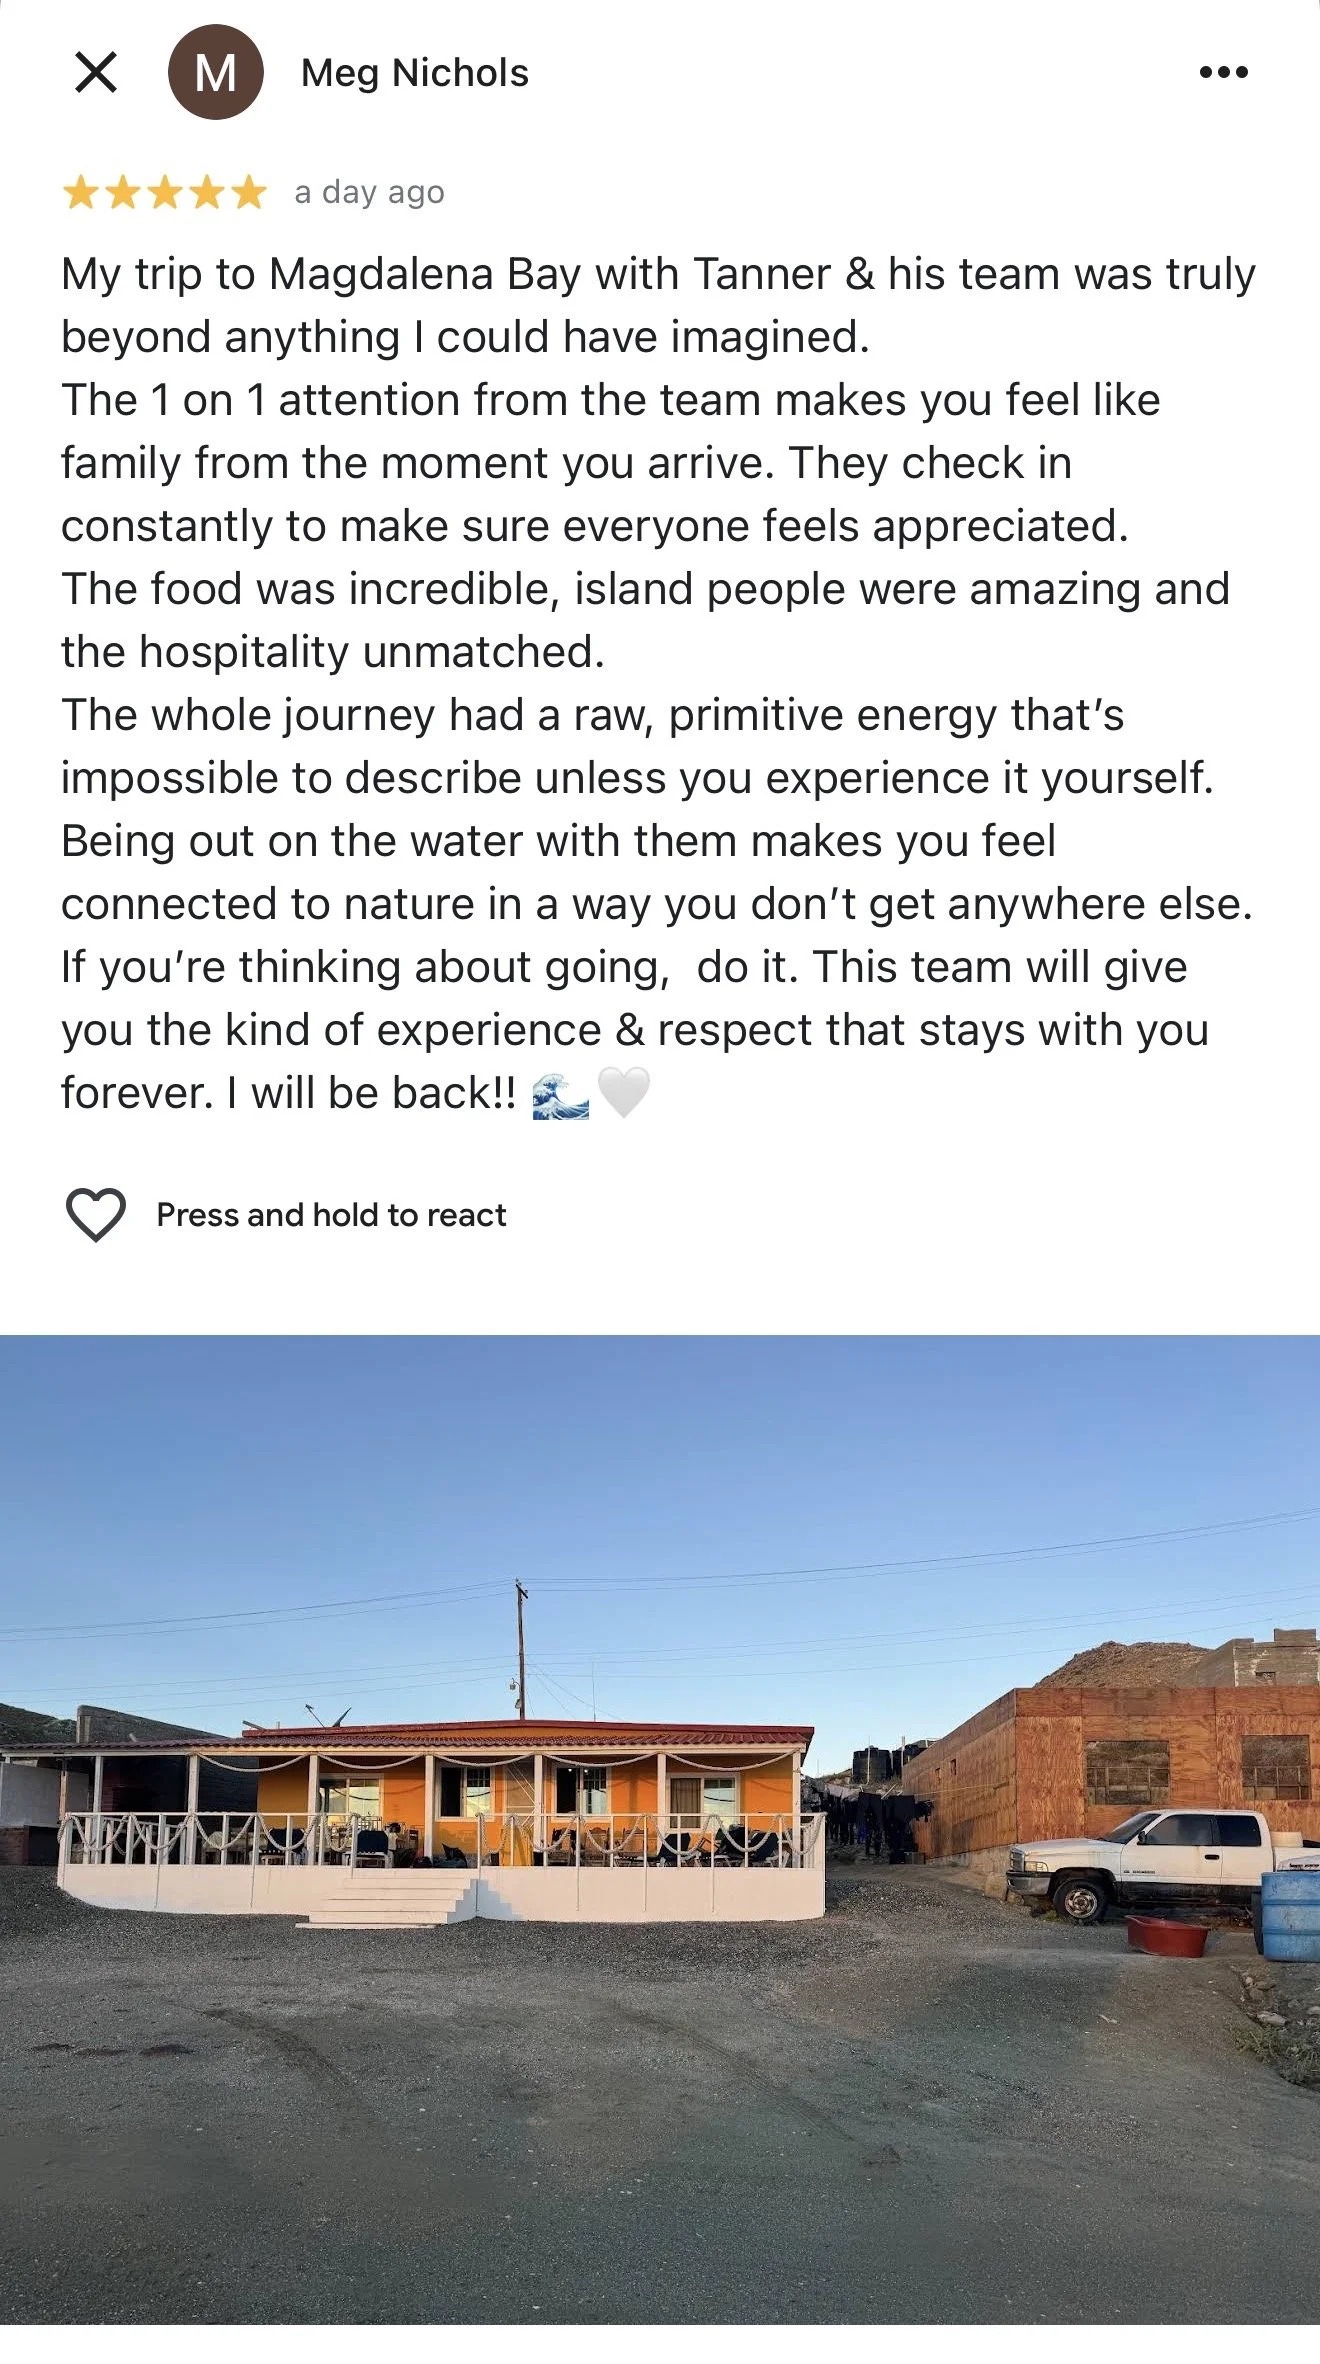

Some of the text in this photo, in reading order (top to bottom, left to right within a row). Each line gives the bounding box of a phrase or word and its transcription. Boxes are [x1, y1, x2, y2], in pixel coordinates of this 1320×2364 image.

[196, 53, 235, 92] M
[302, 55, 529, 94] Meg Nichols
[295, 178, 445, 210] a day ago
[63, 254, 1257, 299] My trip to Magdalena Bay with Tanner & his team was truly
[63, 317, 869, 362] beyond anything I could have imagined.
[61, 380, 1161, 425] The 1 on 1 attention from the team makes you feel like
[60, 443, 1071, 487] family from the moment you arrive. They check in
[61, 506, 1128, 551] constantly to make sure everyone feels appreciated.
[61, 569, 1229, 614] The food was incredible, island people were amazing and
[60, 632, 604, 676] the hospitality unmatched.
[61, 696, 138, 732] The
[151, 696, 272, 732] whole
[281, 695, 436, 739] journey
[451, 696, 523, 732] had
[538, 705, 560, 732] a
[575, 705, 653, 739] raw,
[670, 695, 844, 739] primitive
[857, 705, 998, 740] energy
[62, 758, 1213, 802] impossible to describe unless you experience it yourself.
[63, 821, 1055, 866] Being out on the water with them makes you feel
[61, 885, 276, 921] connected
[290, 888, 330, 921] to
[345, 888, 475, 921] nature
[489, 884, 521, 920] in
[536, 894, 558, 921] a
[571, 894, 652, 928] way
[664, 894, 736, 929] you
[869, 888, 935, 929] get
[948, 885, 1146, 928] anywhere
[1159, 885, 1252, 921] else.
[63, 947, 87, 983] If
[238, 947, 400, 992] thinking
[415, 948, 531, 984] about
[545, 947, 669, 992] going,
[697, 948, 748, 984] do
[763, 947, 798, 983] it.
[812, 947, 897, 984] This
[910, 951, 1011, 984] team
[1026, 947, 1089, 983] will
[1104, 947, 1188, 992] give
[61, 1010, 1208, 1055] you the kind of experience & respect that stays with you
[60, 1073, 515, 1110] forever. I will be back!!
[157, 1201, 507, 1228] Press and hold to react
